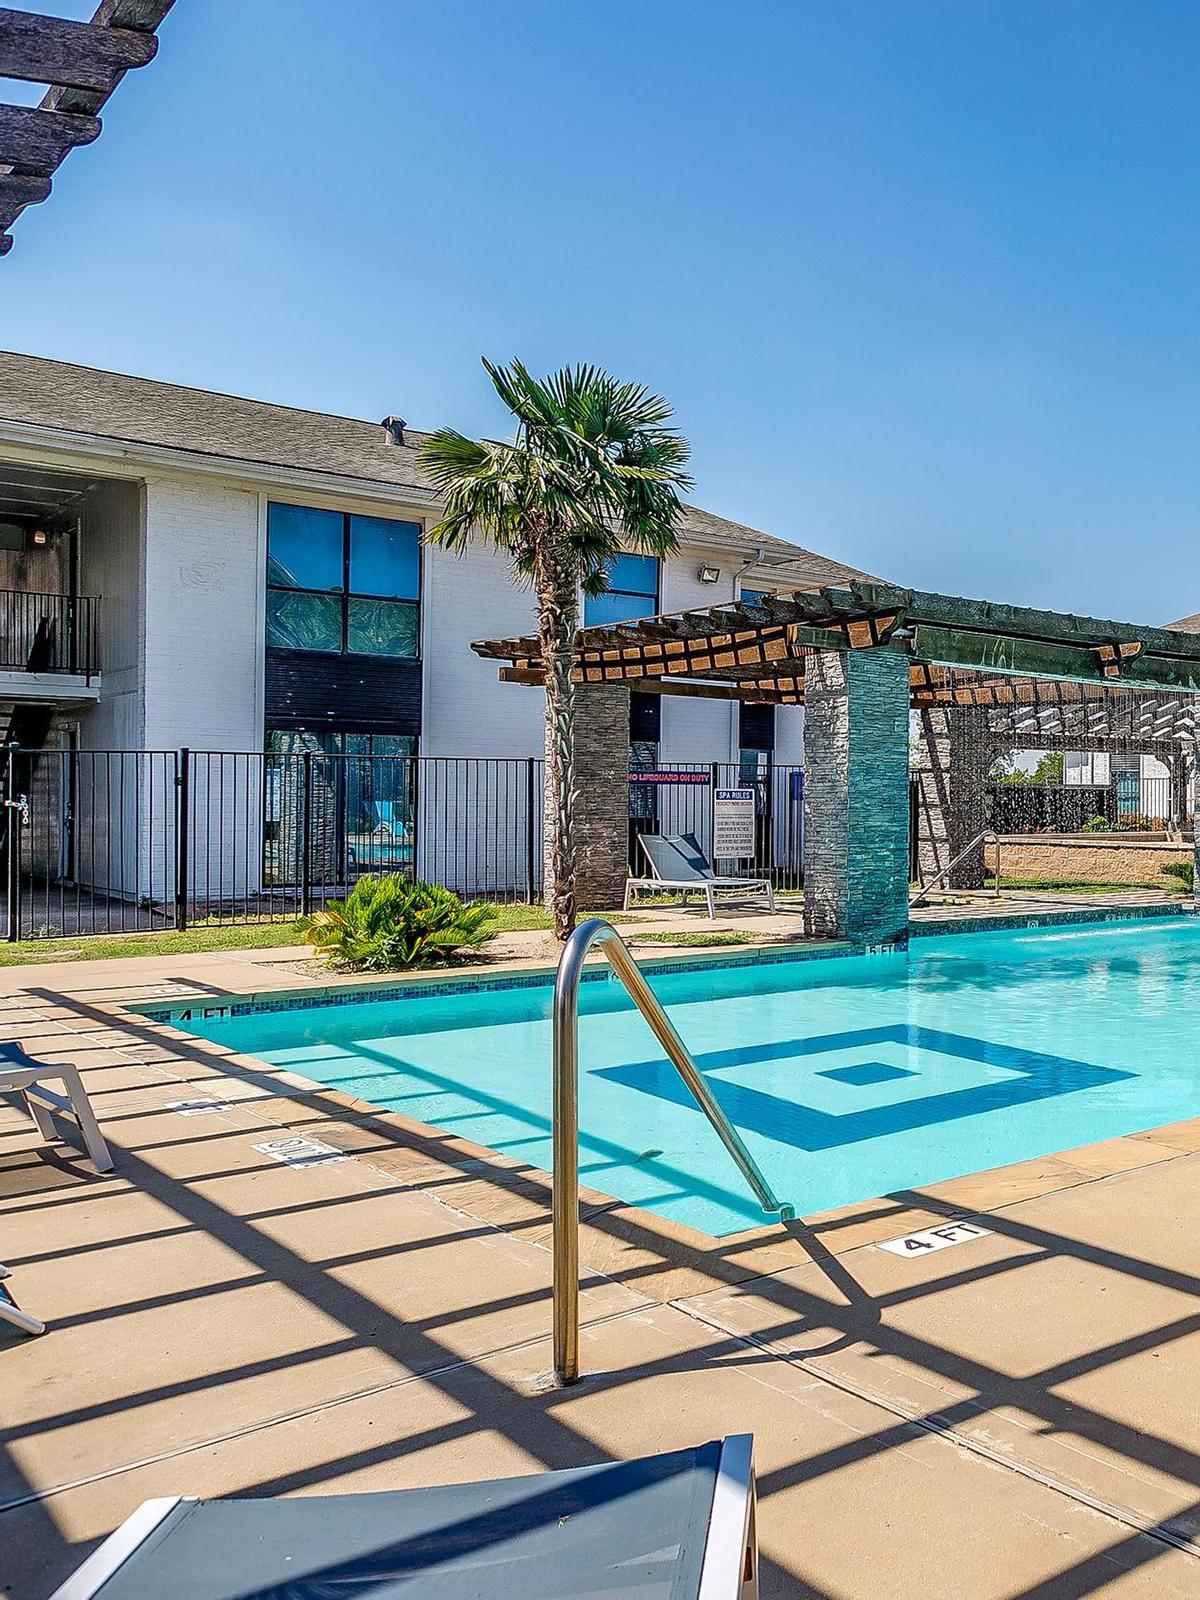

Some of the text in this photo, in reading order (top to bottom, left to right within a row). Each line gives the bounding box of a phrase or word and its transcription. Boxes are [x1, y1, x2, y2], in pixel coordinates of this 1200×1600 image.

[639, 773, 678, 782] LIFEGUARD
[680, 774, 690, 782] ON
[691, 774, 709, 782] DUTY
[719, 791, 750, 799] SPA RULES
[203, 1006, 229, 1019] FT
[904, 1224, 980, 1251] 4 FT
